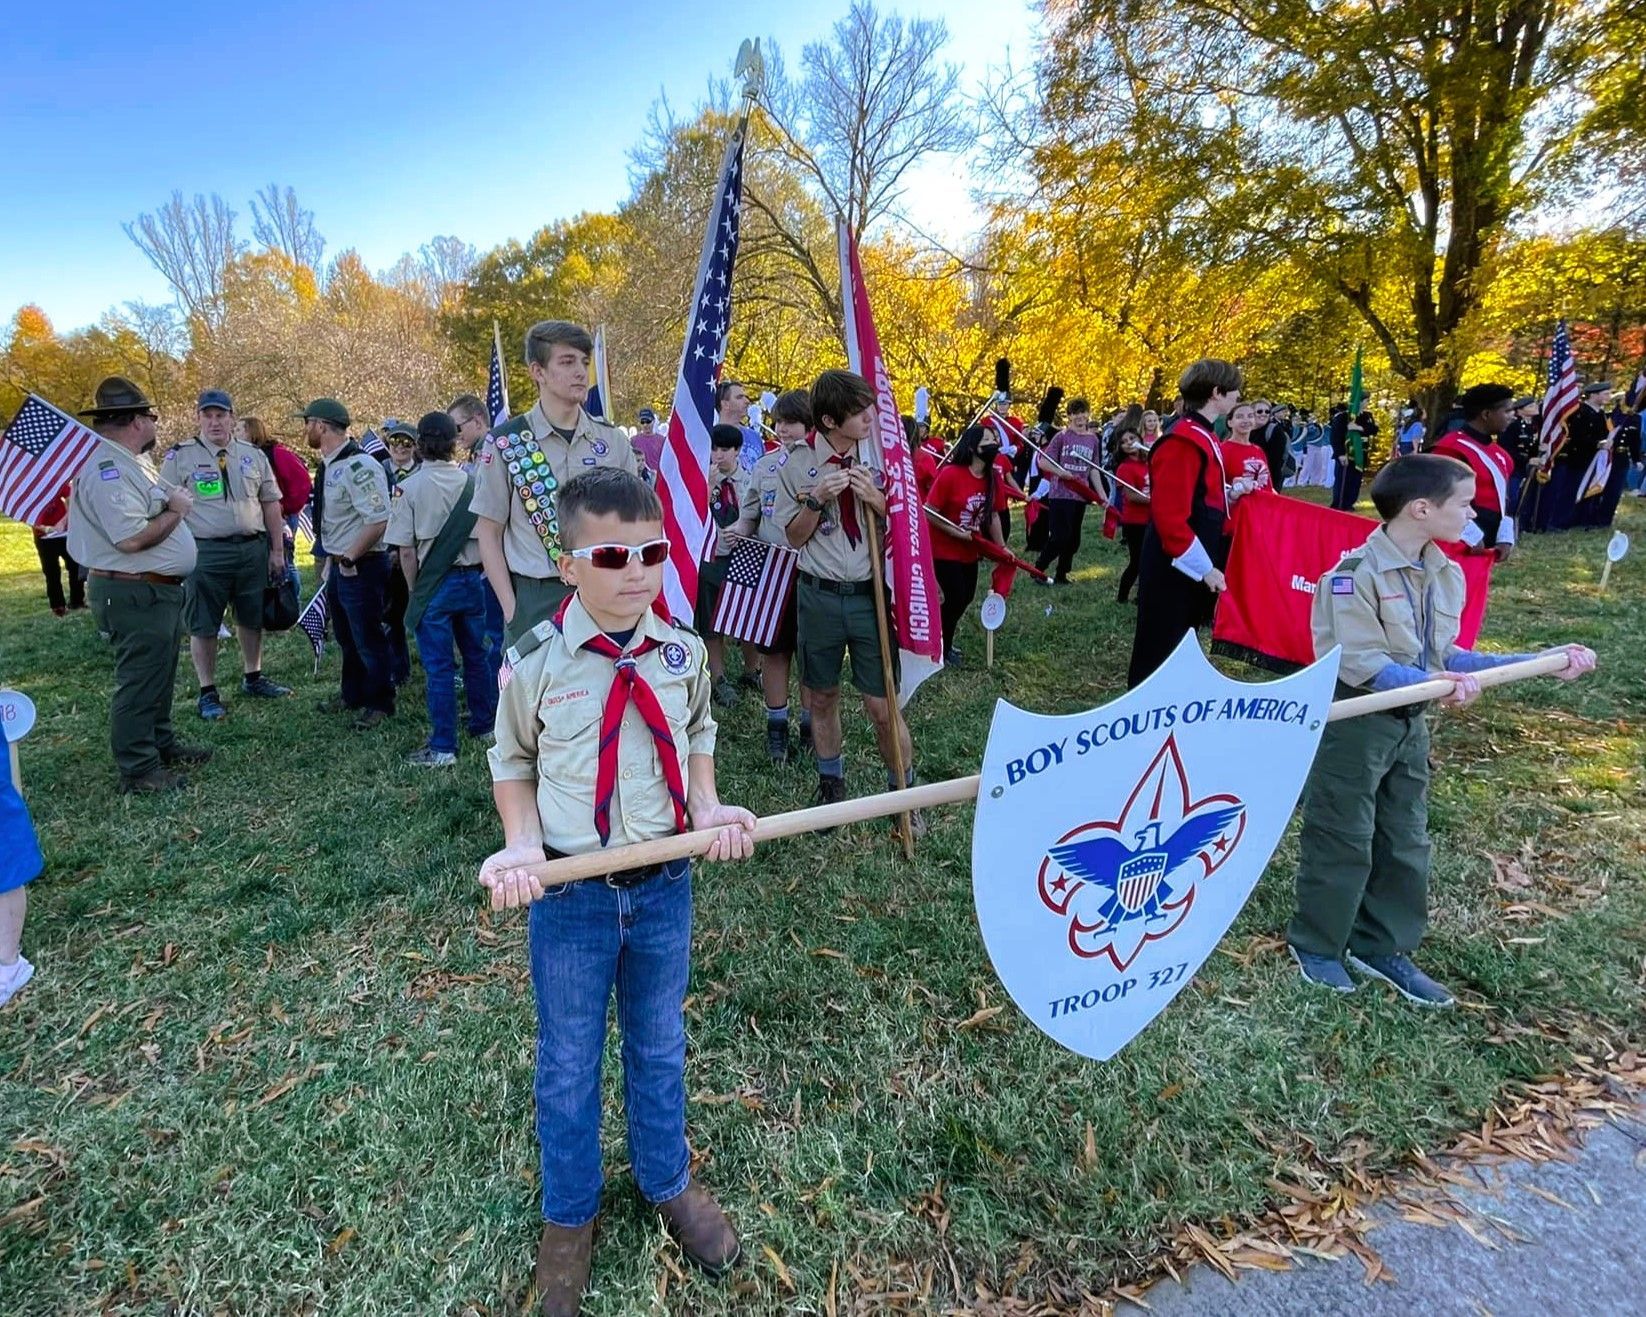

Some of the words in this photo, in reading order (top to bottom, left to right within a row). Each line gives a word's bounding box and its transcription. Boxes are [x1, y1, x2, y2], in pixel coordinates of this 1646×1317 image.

[1291, 574, 1317, 594] Mar
[566, 688, 589, 700] AMERICA
[1006, 737, 1068, 786] BOY
[1075, 705, 1178, 755] SCOUTS
[1182, 699, 1217, 724] OF
[1216, 697, 1309, 725] AMERICA
[1049, 978, 1138, 1020] TROOP
[1146, 961, 1190, 991] 327
